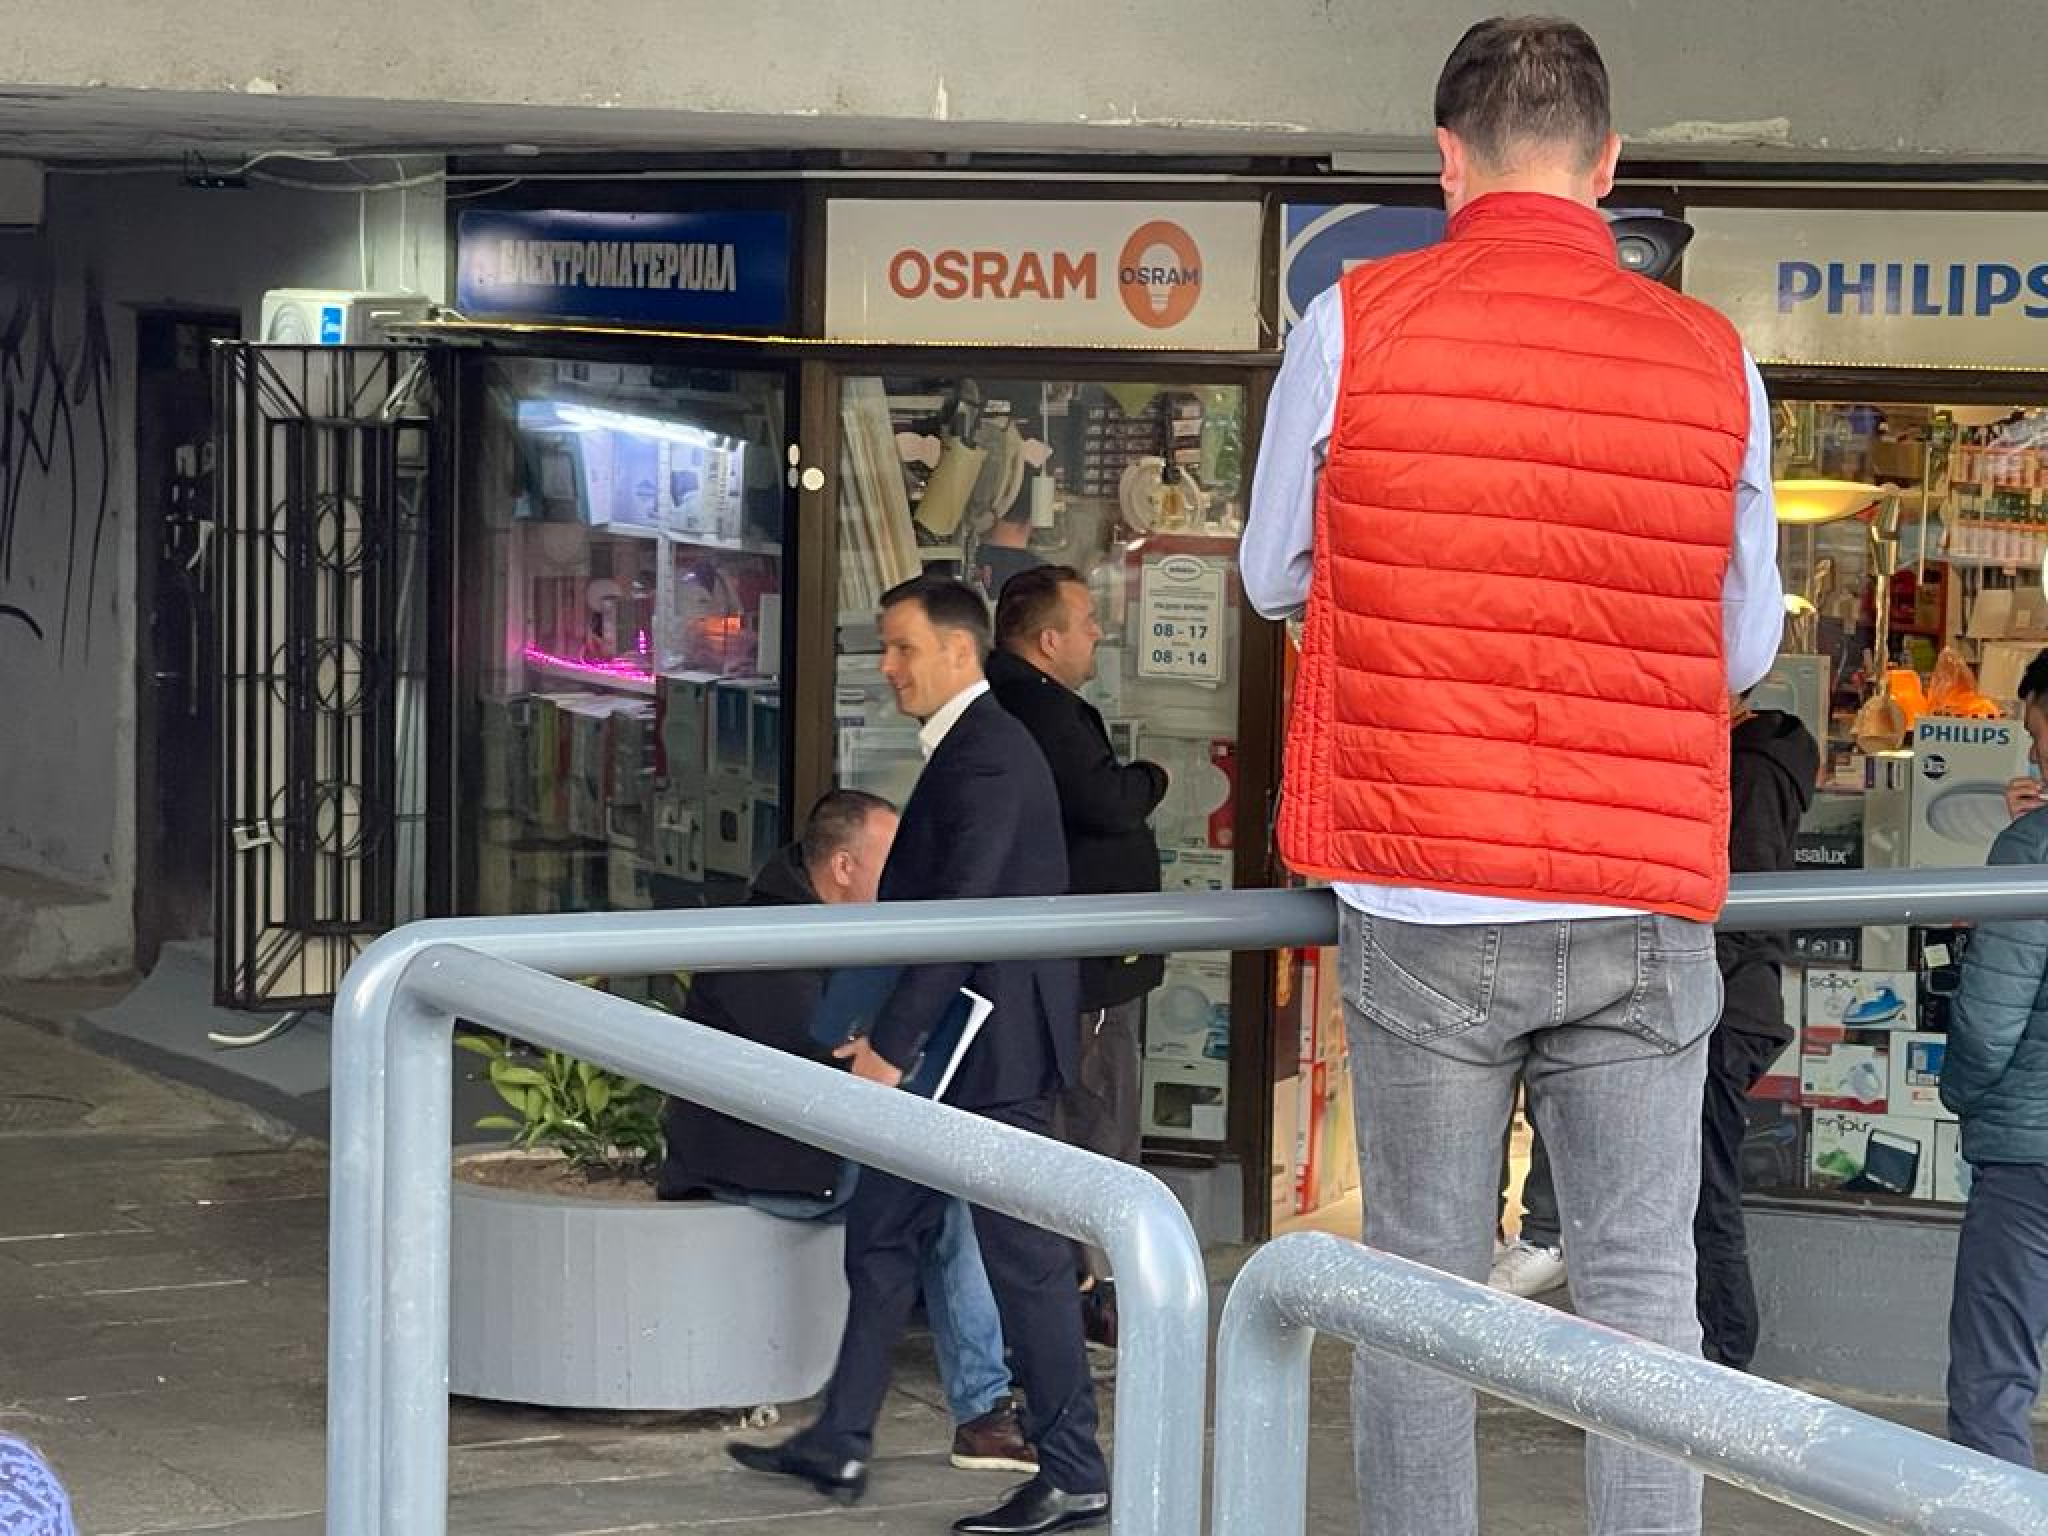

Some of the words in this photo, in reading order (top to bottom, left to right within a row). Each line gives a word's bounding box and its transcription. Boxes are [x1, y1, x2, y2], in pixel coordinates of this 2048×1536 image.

[889, 249, 1098, 300] OSRAM
[1119, 266, 1200, 287] OSRAM
[1777, 261, 2048, 319] PHILIPS
[1152, 623, 1174, 638] 08
[1188, 625, 1209, 639] 17
[1151, 649, 1173, 664] 08
[1187, 651, 1207, 665] 14
[1919, 723, 2011, 745] PHILIPS
